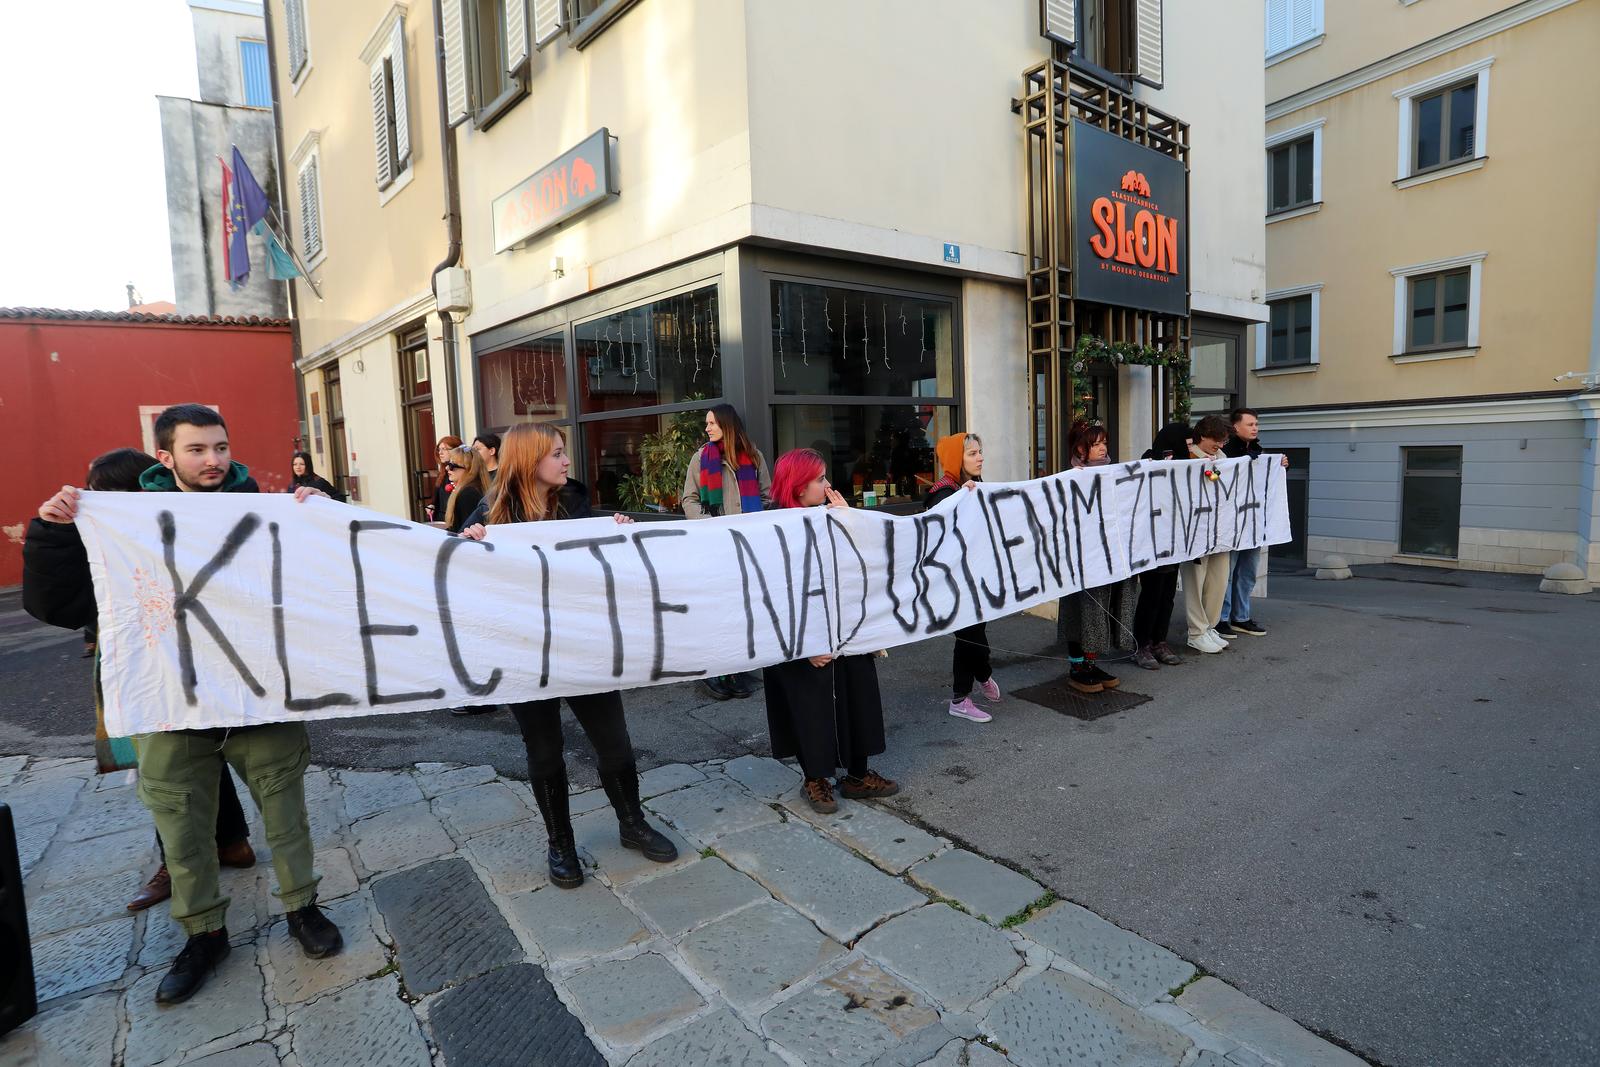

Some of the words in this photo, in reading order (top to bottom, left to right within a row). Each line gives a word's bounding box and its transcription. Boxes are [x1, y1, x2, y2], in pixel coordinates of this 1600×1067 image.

[521, 165, 568, 226] SLON
[949, 245, 955, 257] 4
[1090, 196, 1179, 275] SLON
[1101, 262, 1109, 271] BY
[1112, 265, 1137, 276] MORENO
[728, 513, 867, 661] NAD
[883, 473, 1112, 634] UBIJENIM
[1116, 456, 1272, 571] ŽENAMA!
